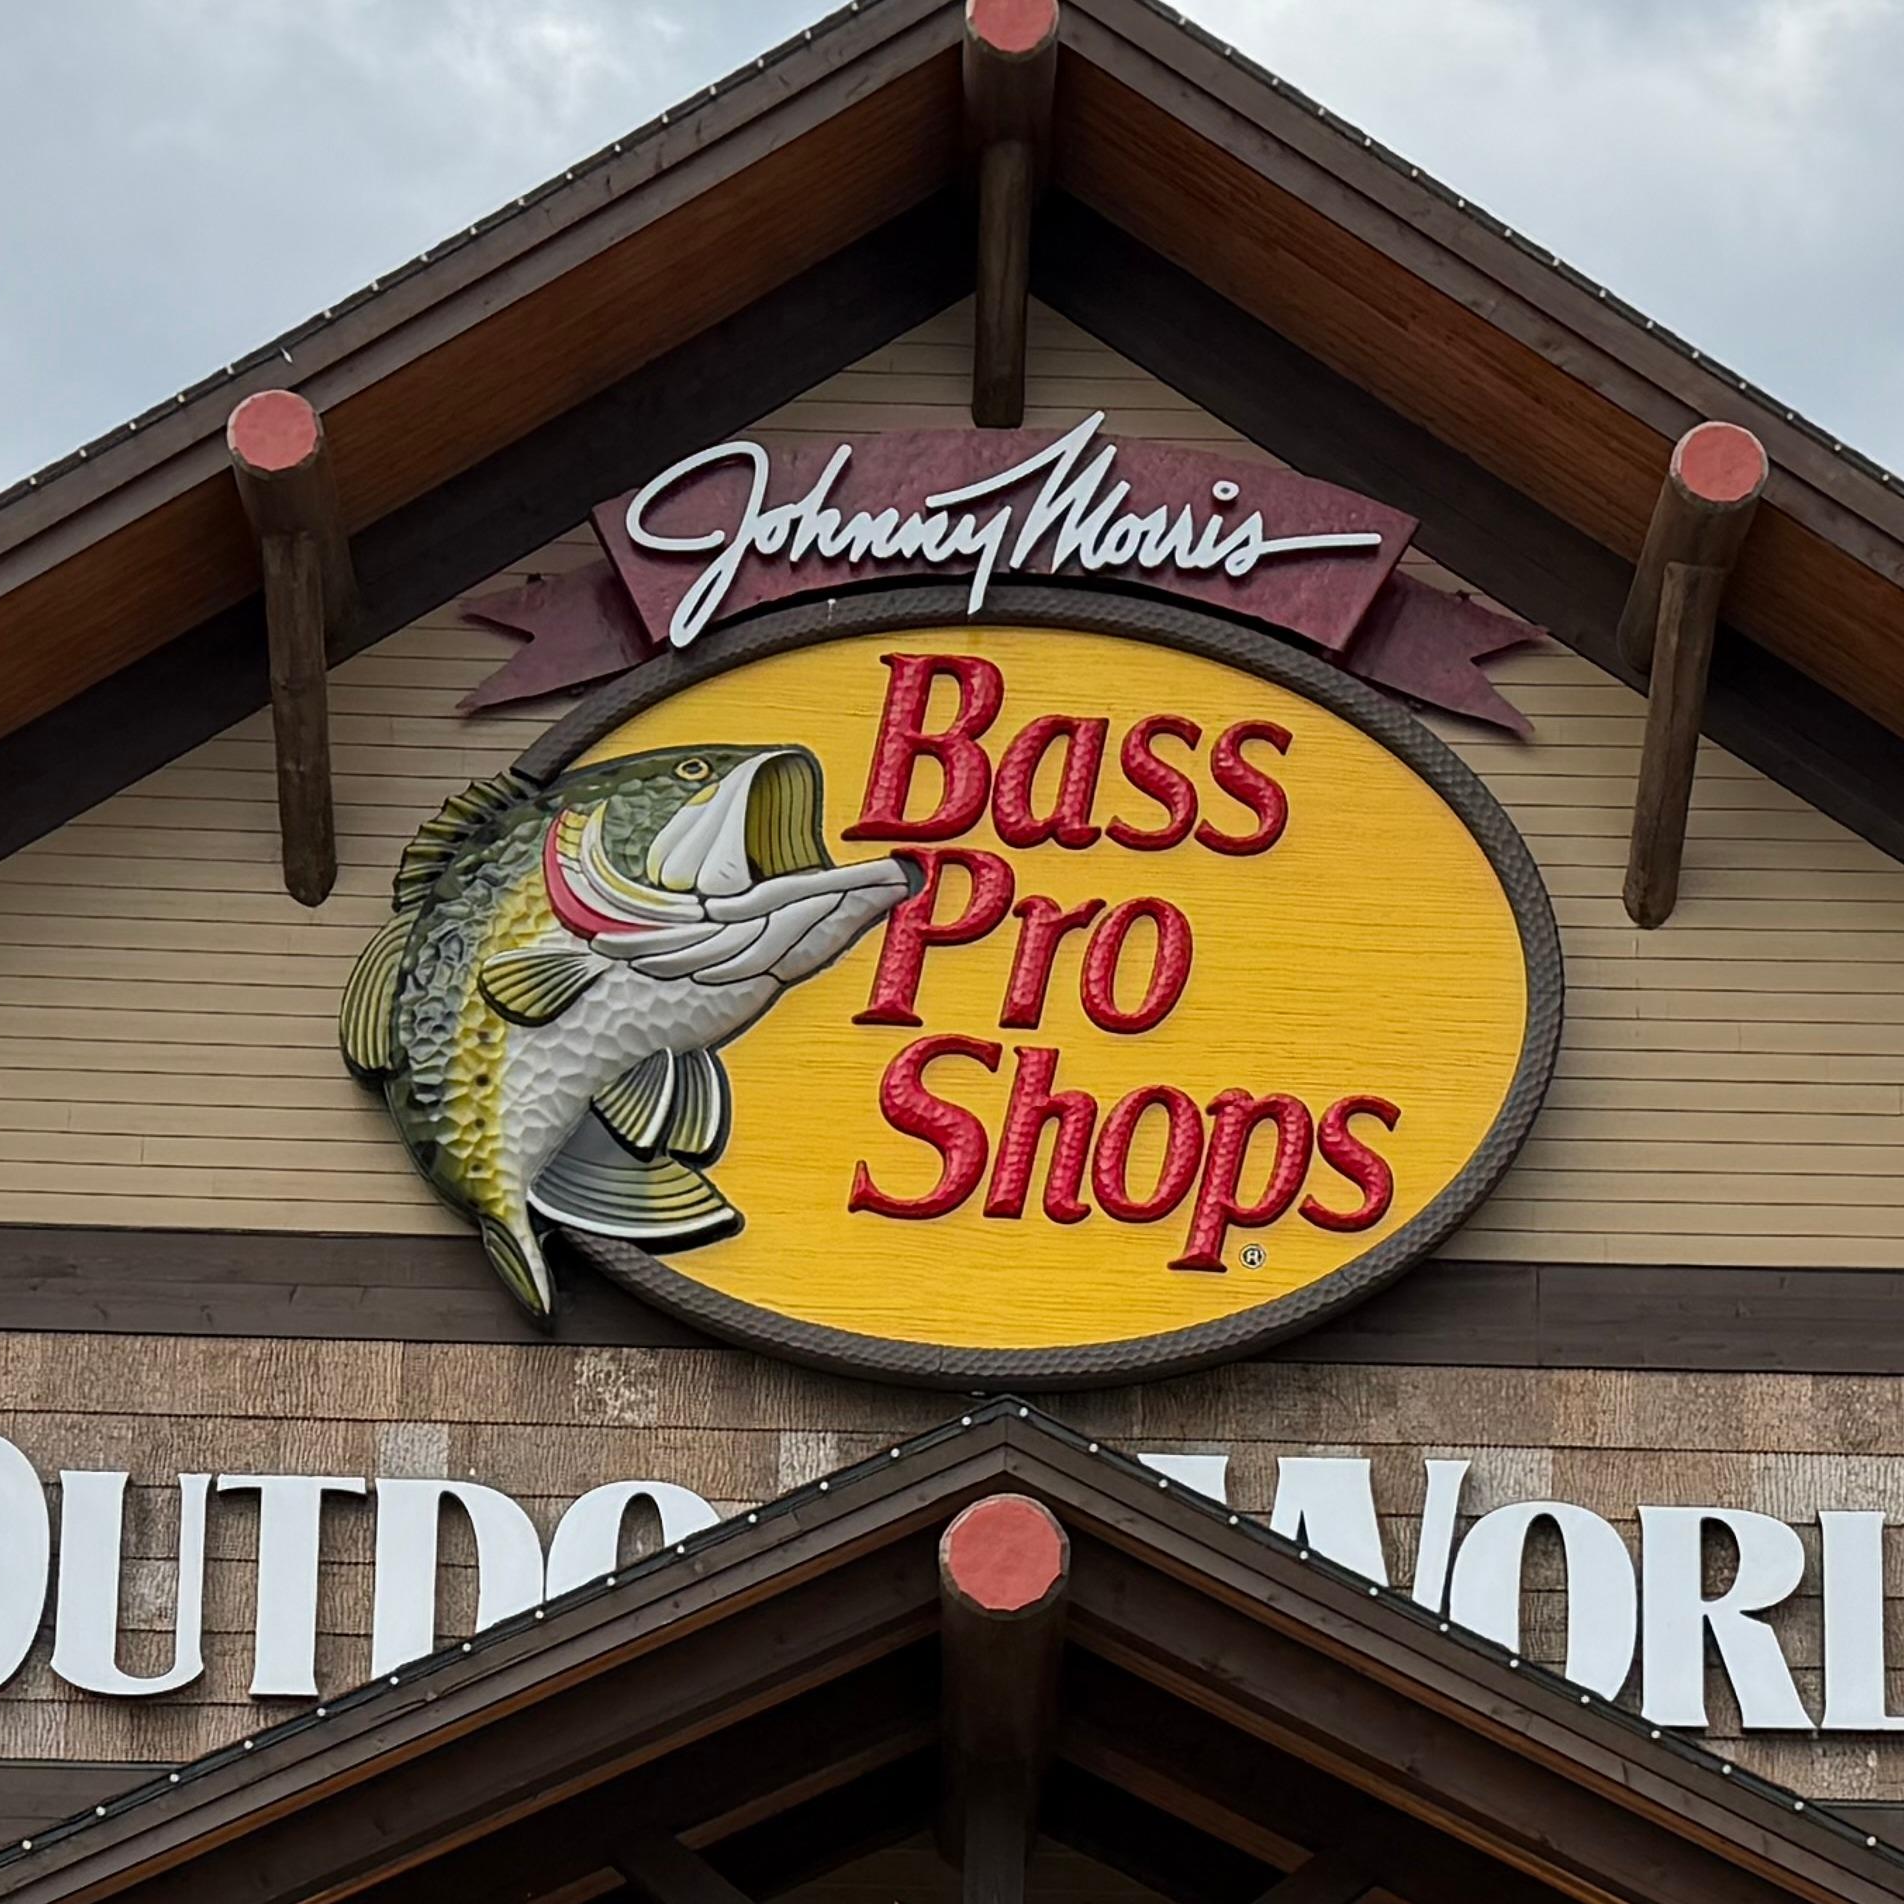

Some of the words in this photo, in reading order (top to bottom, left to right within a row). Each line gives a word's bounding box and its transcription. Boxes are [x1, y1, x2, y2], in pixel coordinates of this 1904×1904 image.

[625, 440, 1004, 646] Johnny
[927, 410, 1382, 577] Morris
[840, 652, 1294, 857] Bass
[851, 847, 1194, 1034] Pro
[847, 1032, 1402, 1272] Shops
